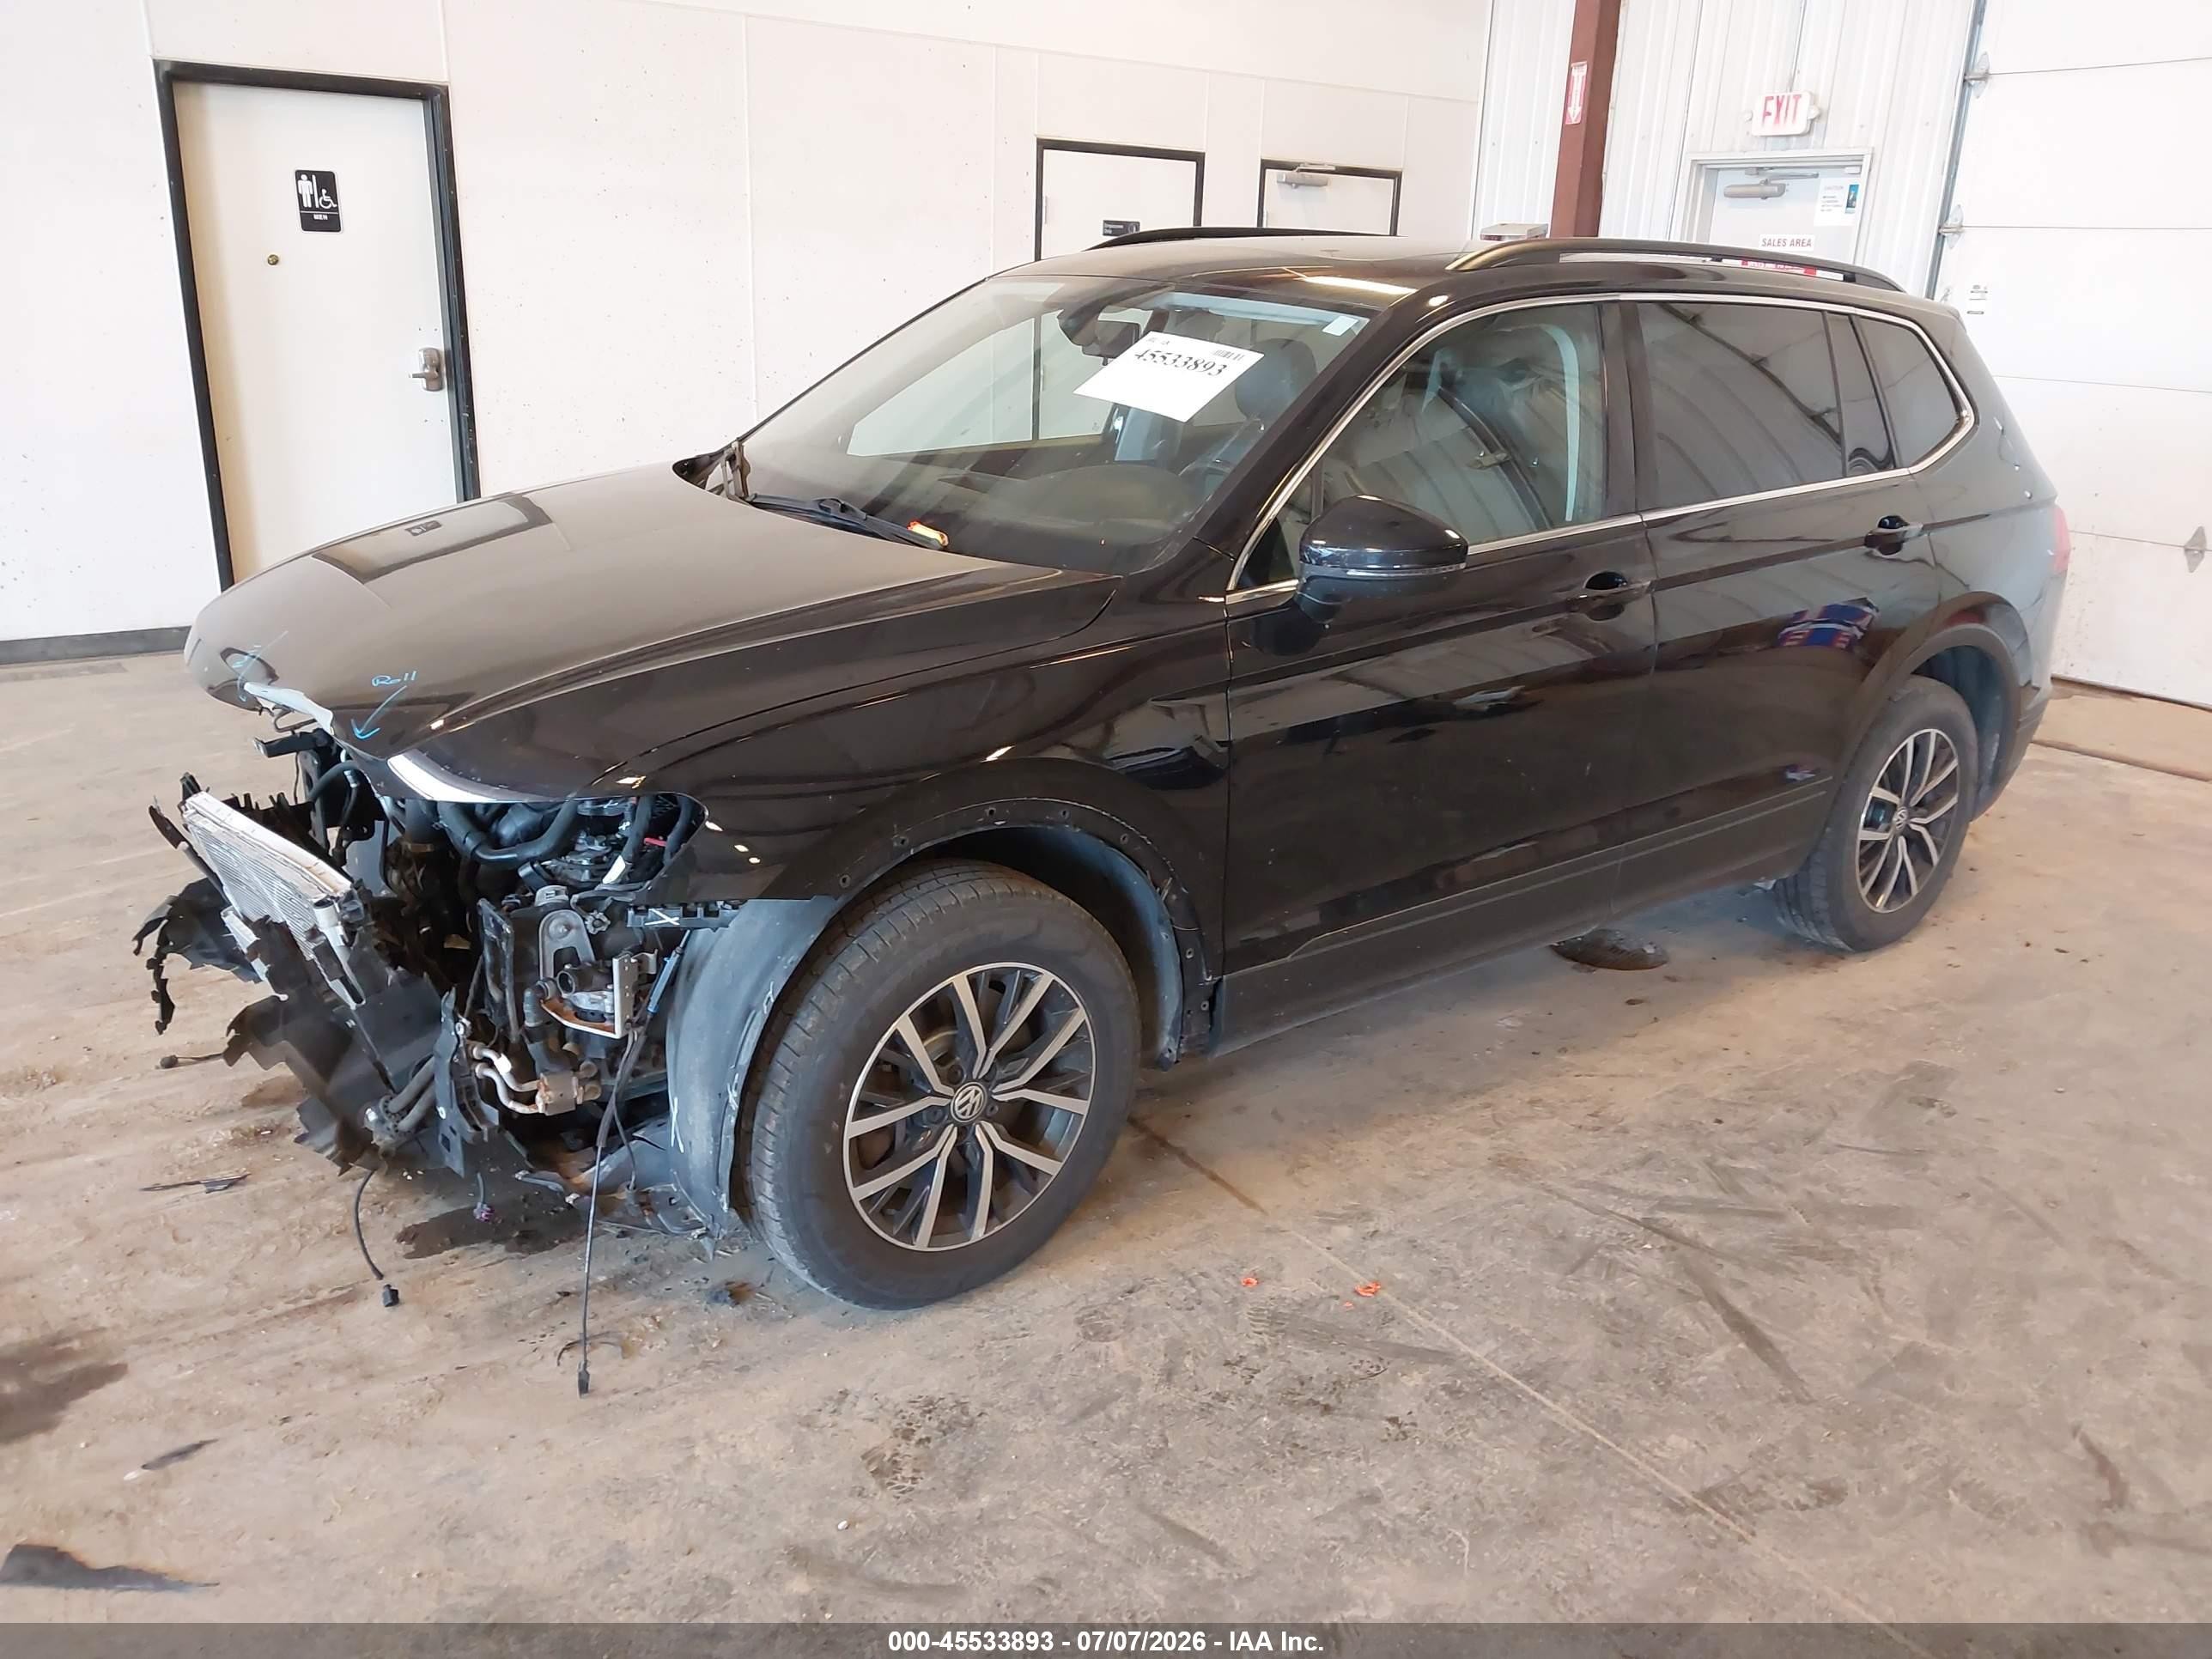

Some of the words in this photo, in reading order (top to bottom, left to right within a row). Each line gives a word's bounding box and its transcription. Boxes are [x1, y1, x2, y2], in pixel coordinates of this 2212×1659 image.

[1761, 237, 1787, 247] SALES
[1789, 238, 1812, 247] AREA
[1134, 349, 1228, 376] 45533893
